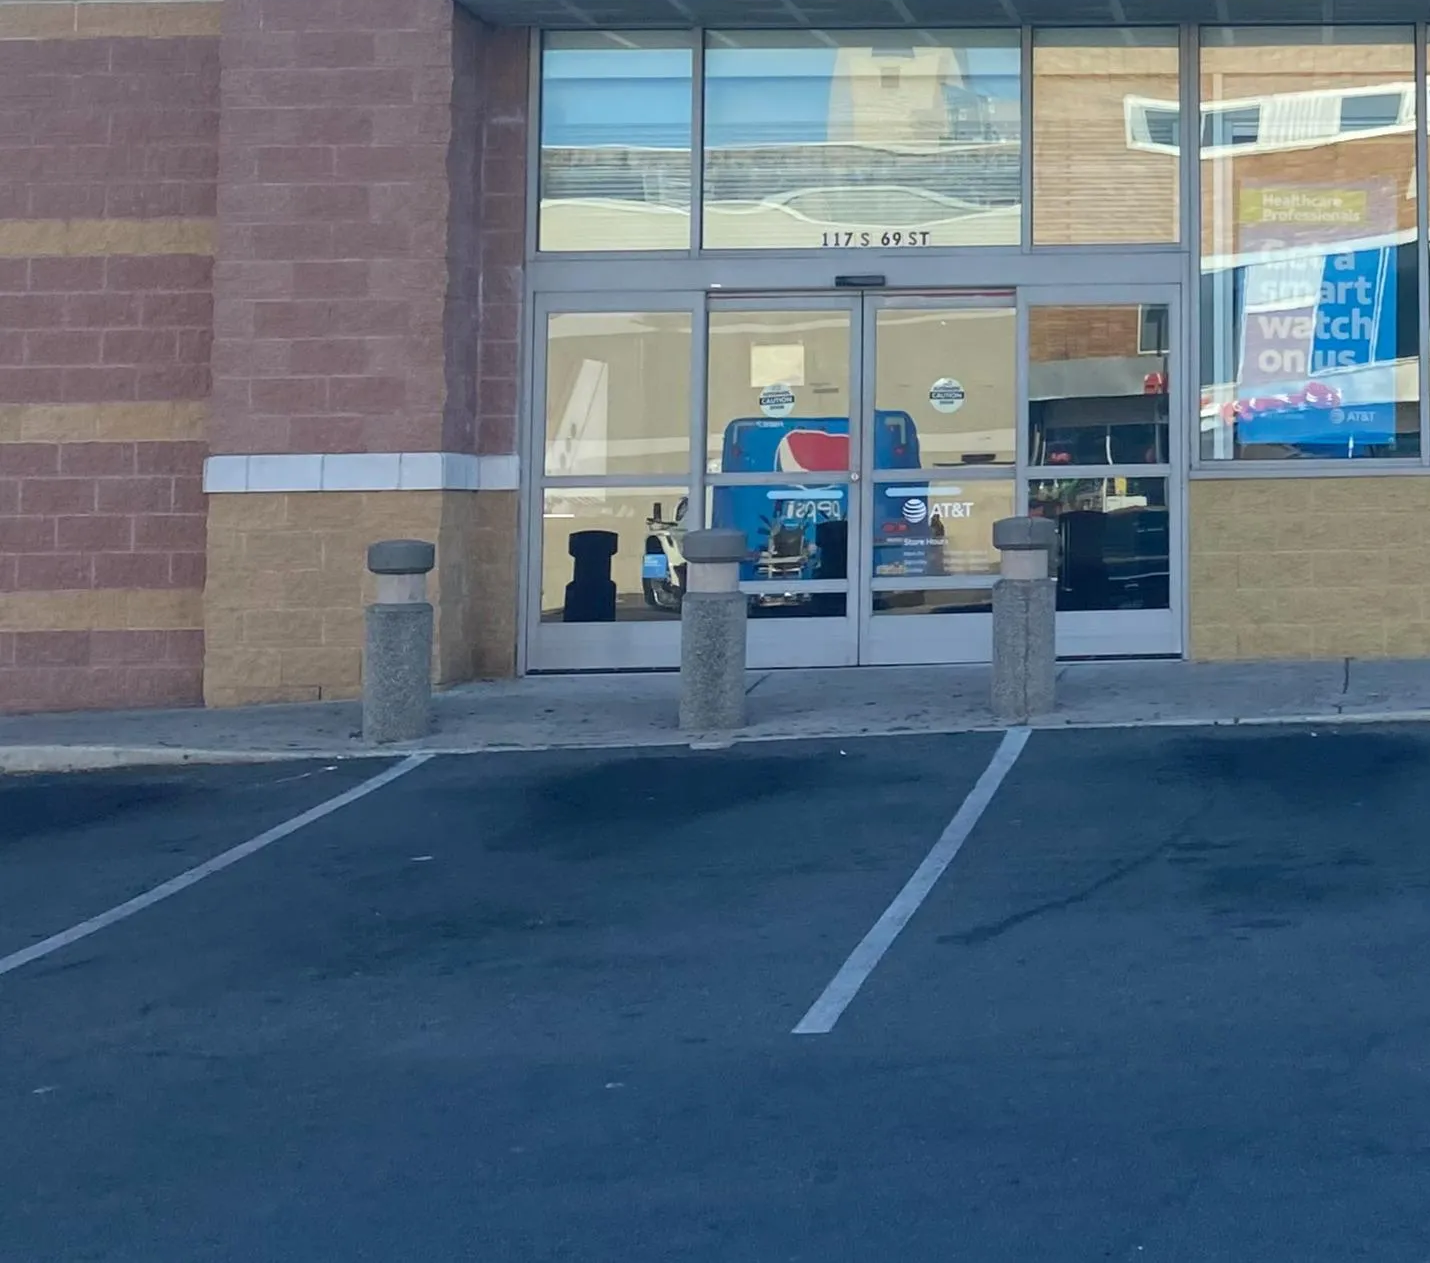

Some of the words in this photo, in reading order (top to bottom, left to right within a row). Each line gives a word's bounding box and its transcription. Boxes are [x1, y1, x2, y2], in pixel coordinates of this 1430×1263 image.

[1262, 193, 1343, 207] Healthcare
[1262, 209, 1362, 222] Professionals
[822, 232, 853, 246] 117
[860, 232, 870, 246] S
[881, 231, 901, 246] 69
[908, 231, 930, 246] ST
[1333, 246, 1355, 271] a
[1260, 276, 1373, 306] smart
[1257, 308, 1373, 340] watch
[1258, 348, 1305, 373] on
[1314, 350, 1356, 372] us
[1347, 411, 1376, 422] AT&T
[929, 502, 975, 519] AT&T
[903, 538, 925, 546] Store
